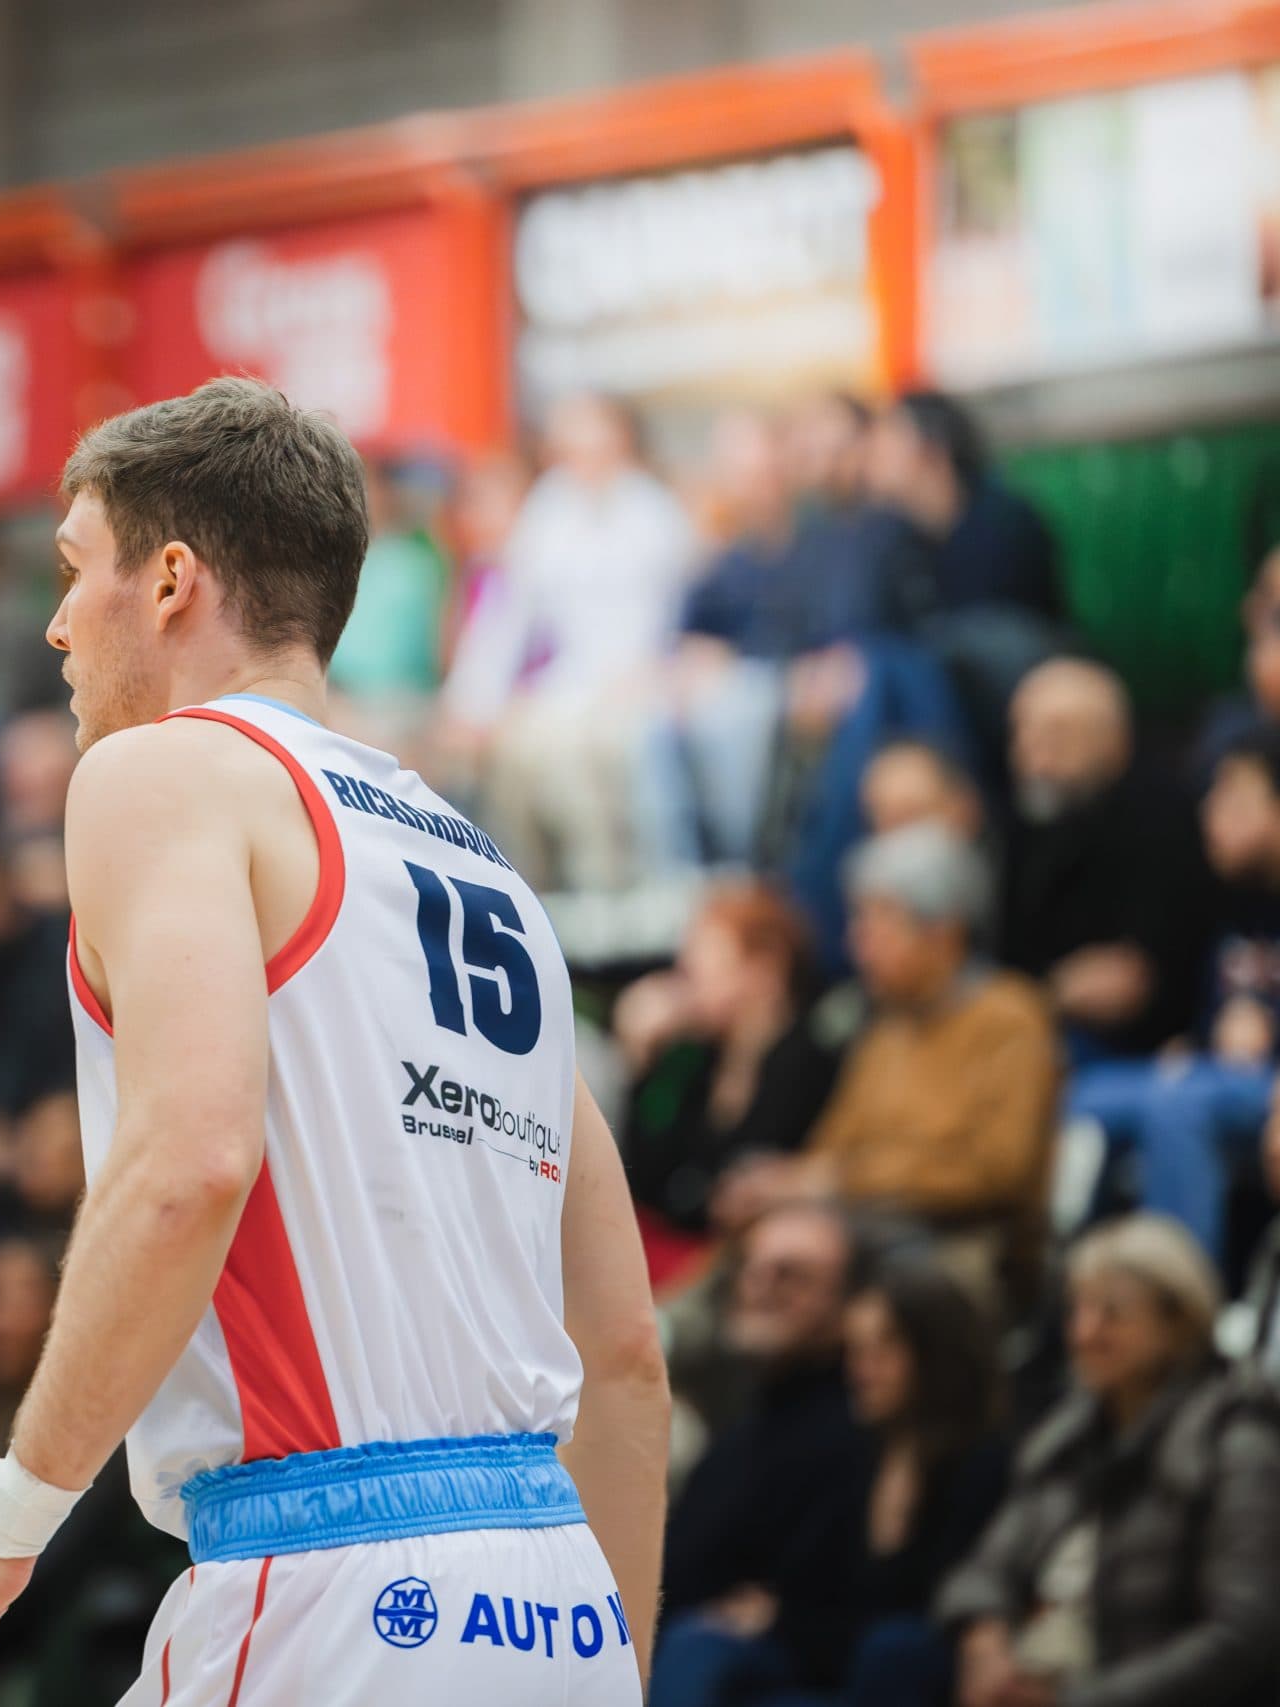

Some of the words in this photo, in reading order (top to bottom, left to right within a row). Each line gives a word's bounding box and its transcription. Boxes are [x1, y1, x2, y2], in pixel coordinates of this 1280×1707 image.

[403, 859, 542, 1056] 15
[529, 1155, 539, 1177] by
[540, 1160, 561, 1185] RO
